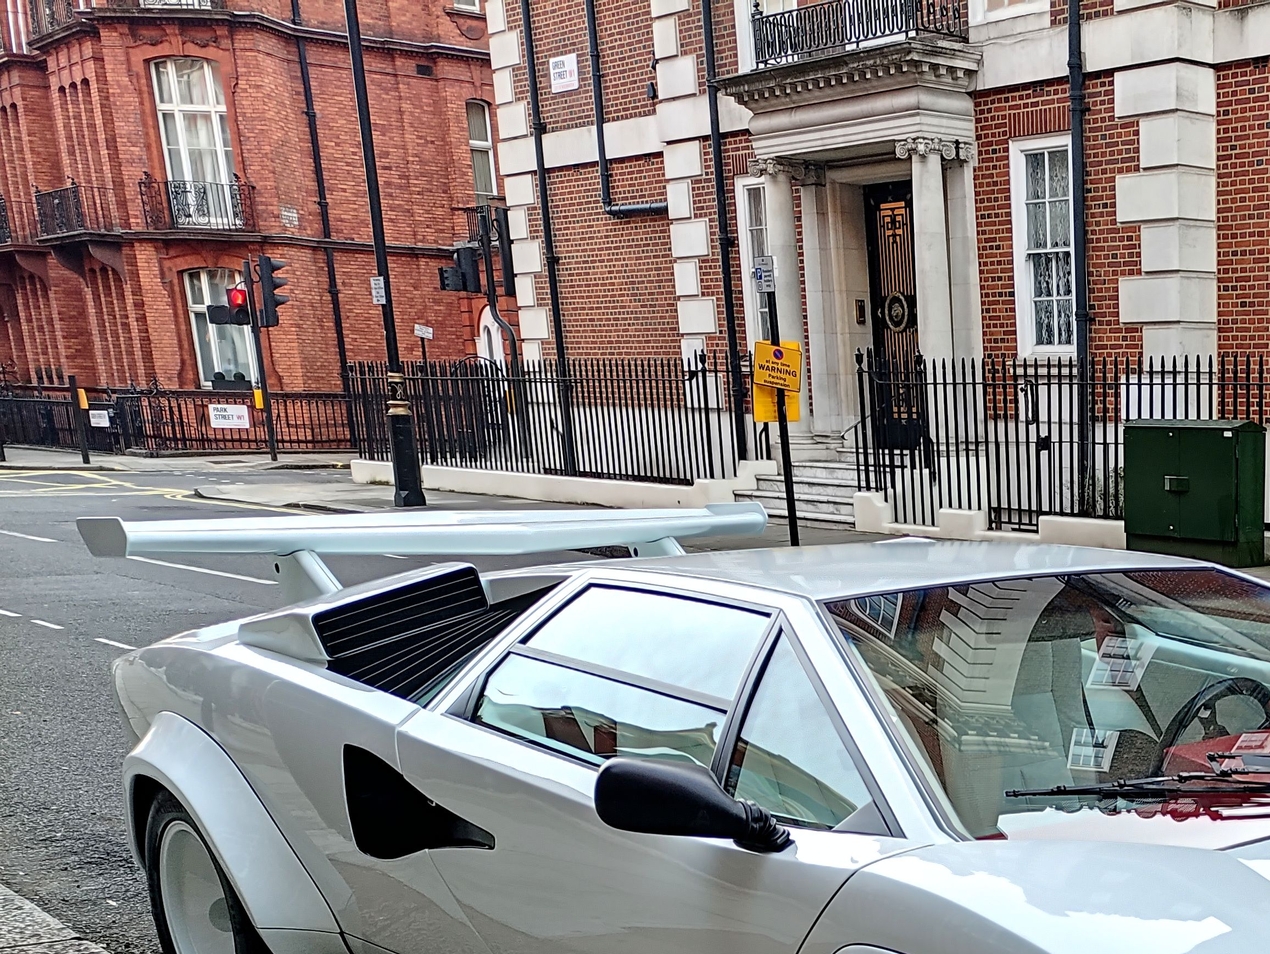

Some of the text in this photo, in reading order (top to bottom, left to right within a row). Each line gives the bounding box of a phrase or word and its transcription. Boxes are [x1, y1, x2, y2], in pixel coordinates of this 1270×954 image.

[552, 60, 565, 70] GREEN
[553, 70, 567, 81] STREET
[758, 363, 797, 378] WARNING
[768, 374, 786, 382] Parking
[764, 380, 790, 388] suspension
